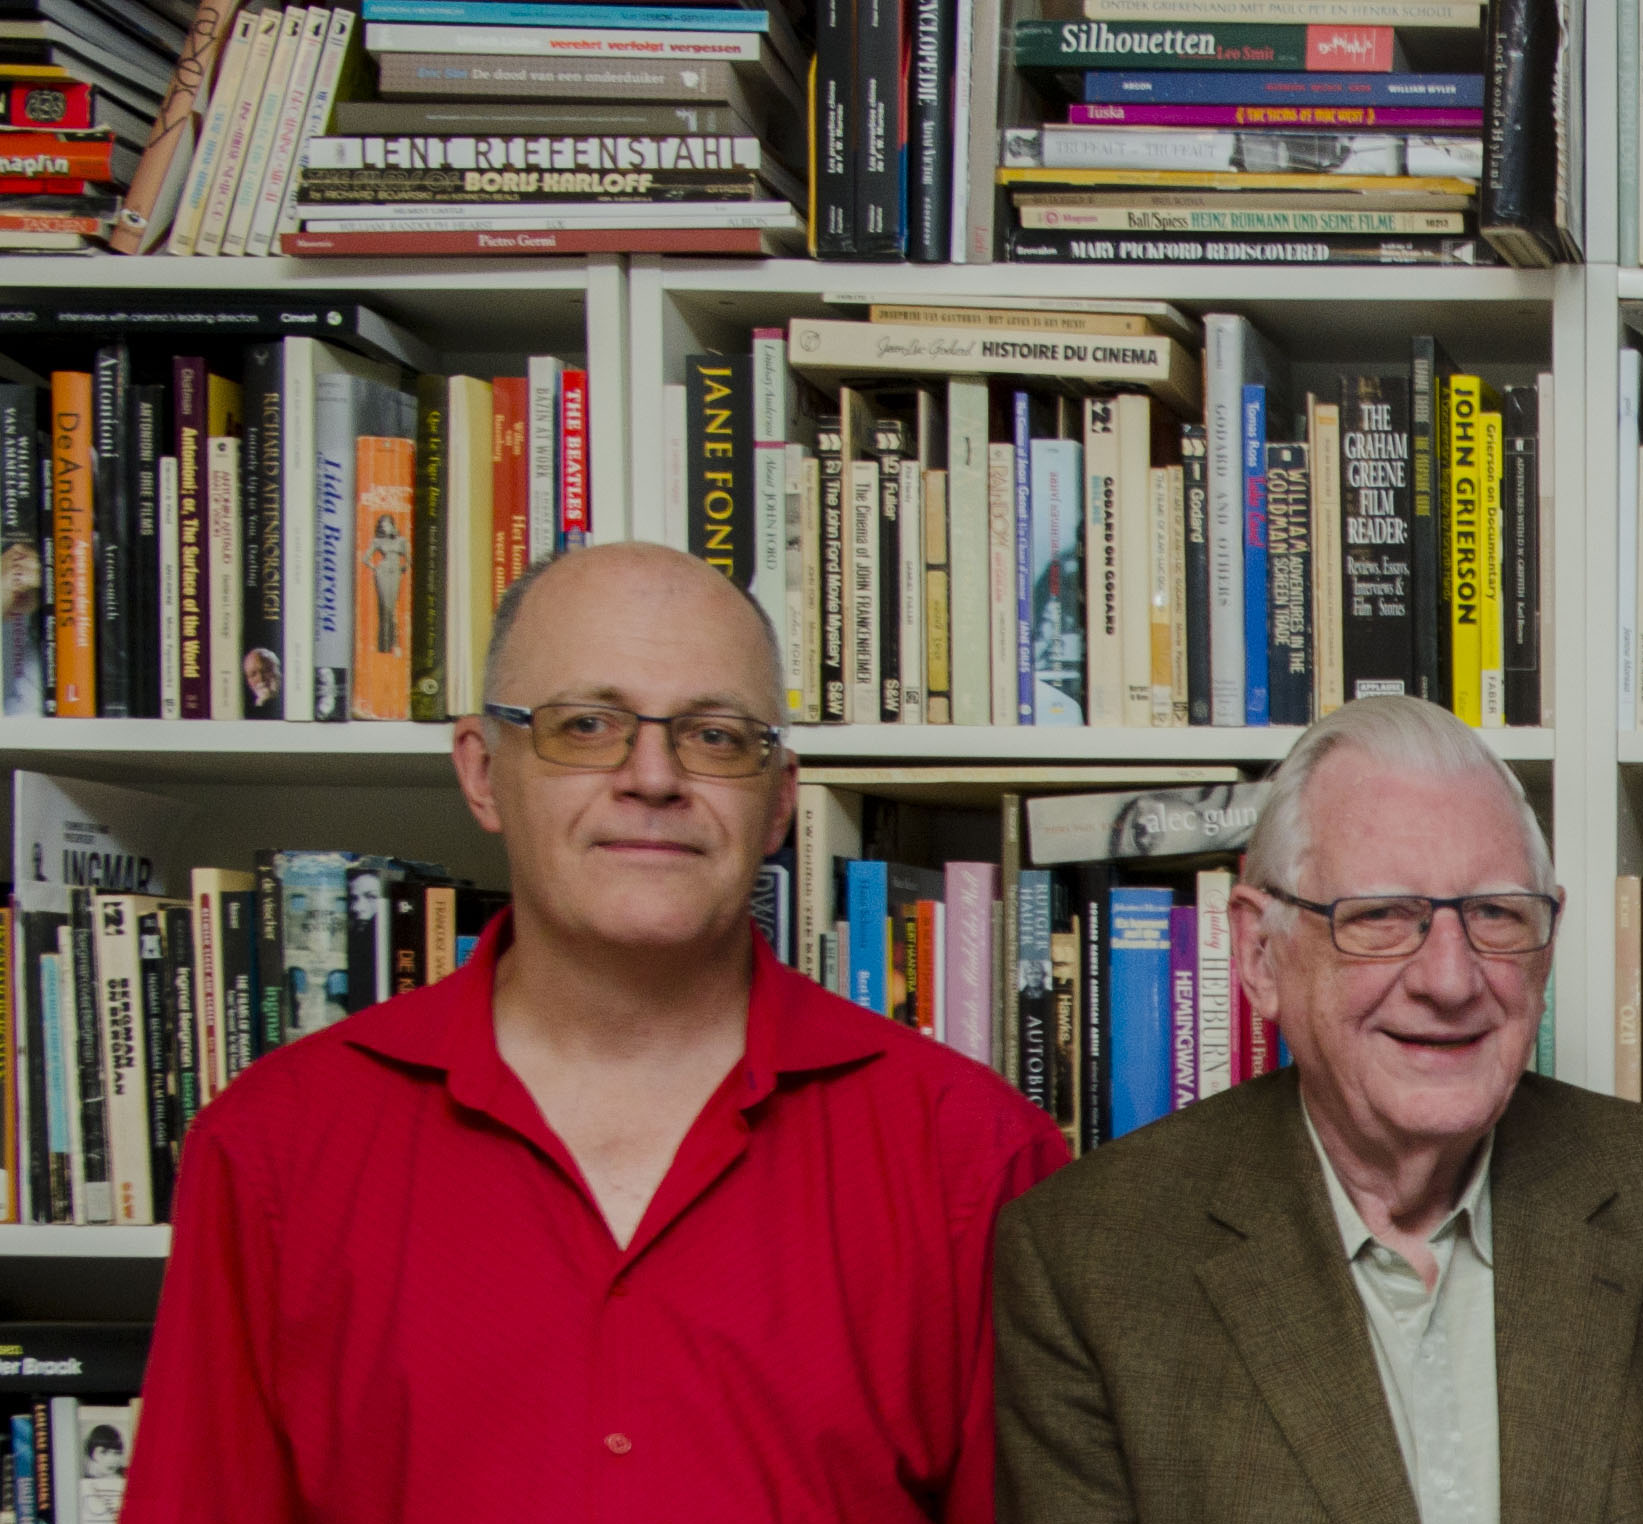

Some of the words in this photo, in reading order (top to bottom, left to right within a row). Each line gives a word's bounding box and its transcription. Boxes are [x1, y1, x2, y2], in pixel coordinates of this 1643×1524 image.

[1061, 23, 1217, 58] Silhouetten
[361, 138, 456, 168] LENI
[475, 138, 749, 169] RIEFENSTAHL
[464, 172, 534, 193] BORIS
[537, 172, 653, 193] KARLOFF
[478, 234, 515, 249] Pietro
[518, 235, 557, 249] Germi
[1071, 241, 1116, 261] MARY
[1118, 241, 1203, 261] PICKFORD
[1206, 241, 1330, 263] REDISCOVERED
[981, 340, 1060, 361] HISTOIRE
[1063, 343, 1088, 362] DU
[1091, 345, 1159, 366] CINEMA
[100, 354, 120, 457] Antonioni
[534, 387, 550, 422] BAZIN
[566, 389, 582, 431] THE
[699, 364, 733, 458] JANE
[1361, 404, 1393, 430] THE
[56, 412, 81, 450] De
[262, 392, 280, 476] RICHARD
[534, 426, 550, 440] AT
[1344, 431, 1409, 459] GRAHAM
[1455, 388, 1475, 469] JOHN
[534, 444, 550, 480] WORK
[1484, 423, 1498, 482] Grierson
[320, 458, 342, 514] Lida
[567, 436, 582, 520] BEATLES
[827, 480, 841, 506] The
[855, 482, 871, 502] The
[1347, 460, 1407, 488] GREENE
[884, 482, 898, 520] Fuller
[1103, 476, 1116, 543] GODARD
[1268, 467, 1288, 554] GOLDMAN
[1287, 467, 1306, 554] WILLIAM
[1359, 489, 1395, 516] FILM
[1485, 486, 1497, 503] on
[181, 519, 199, 543] The
[827, 508, 841, 538] John
[855, 505, 871, 543] Cinema
[1189, 488, 1206, 543] Godard
[56, 456, 84, 627] Andriessens
[260, 479, 282, 621] ATTENBOROUGH
[827, 540, 841, 571] Ford
[856, 547, 871, 559] of
[1104, 545, 1116, 568] ON
[1455, 477, 1478, 625] GRIERSON
[1483, 506, 1499, 601] Documentary
[181, 546, 199, 594] Surface
[320, 525, 341, 634] Baarova
[856, 562, 871, 591] JOHN
[1274, 558, 1289, 606] SCREEN
[181, 598, 199, 612] of
[827, 573, 841, 610] Movie
[1104, 570, 1116, 636] GODARD
[1289, 556, 1304, 634] ADVENTURES
[182, 615, 199, 636] the
[823, 613, 841, 666] Mystery
[856, 594, 871, 684] FRANKENHEIMER
[1275, 608, 1289, 646] TRADE
[1290, 637, 1303, 650] IN
[182, 638, 200, 678] World
[1290, 651, 1304, 674] THE
[110, 978, 124, 1002] ON
[176, 967, 192, 1009] Ingmar
[120, 977, 135, 1068] BERGMAN
[1175, 970, 1192, 1084] HEMINGWAY
[1201, 956, 1230, 1074] HEPBURN
[113, 1006, 126, 1095] BERGMAN
[178, 1010, 193, 1068] Bergman
